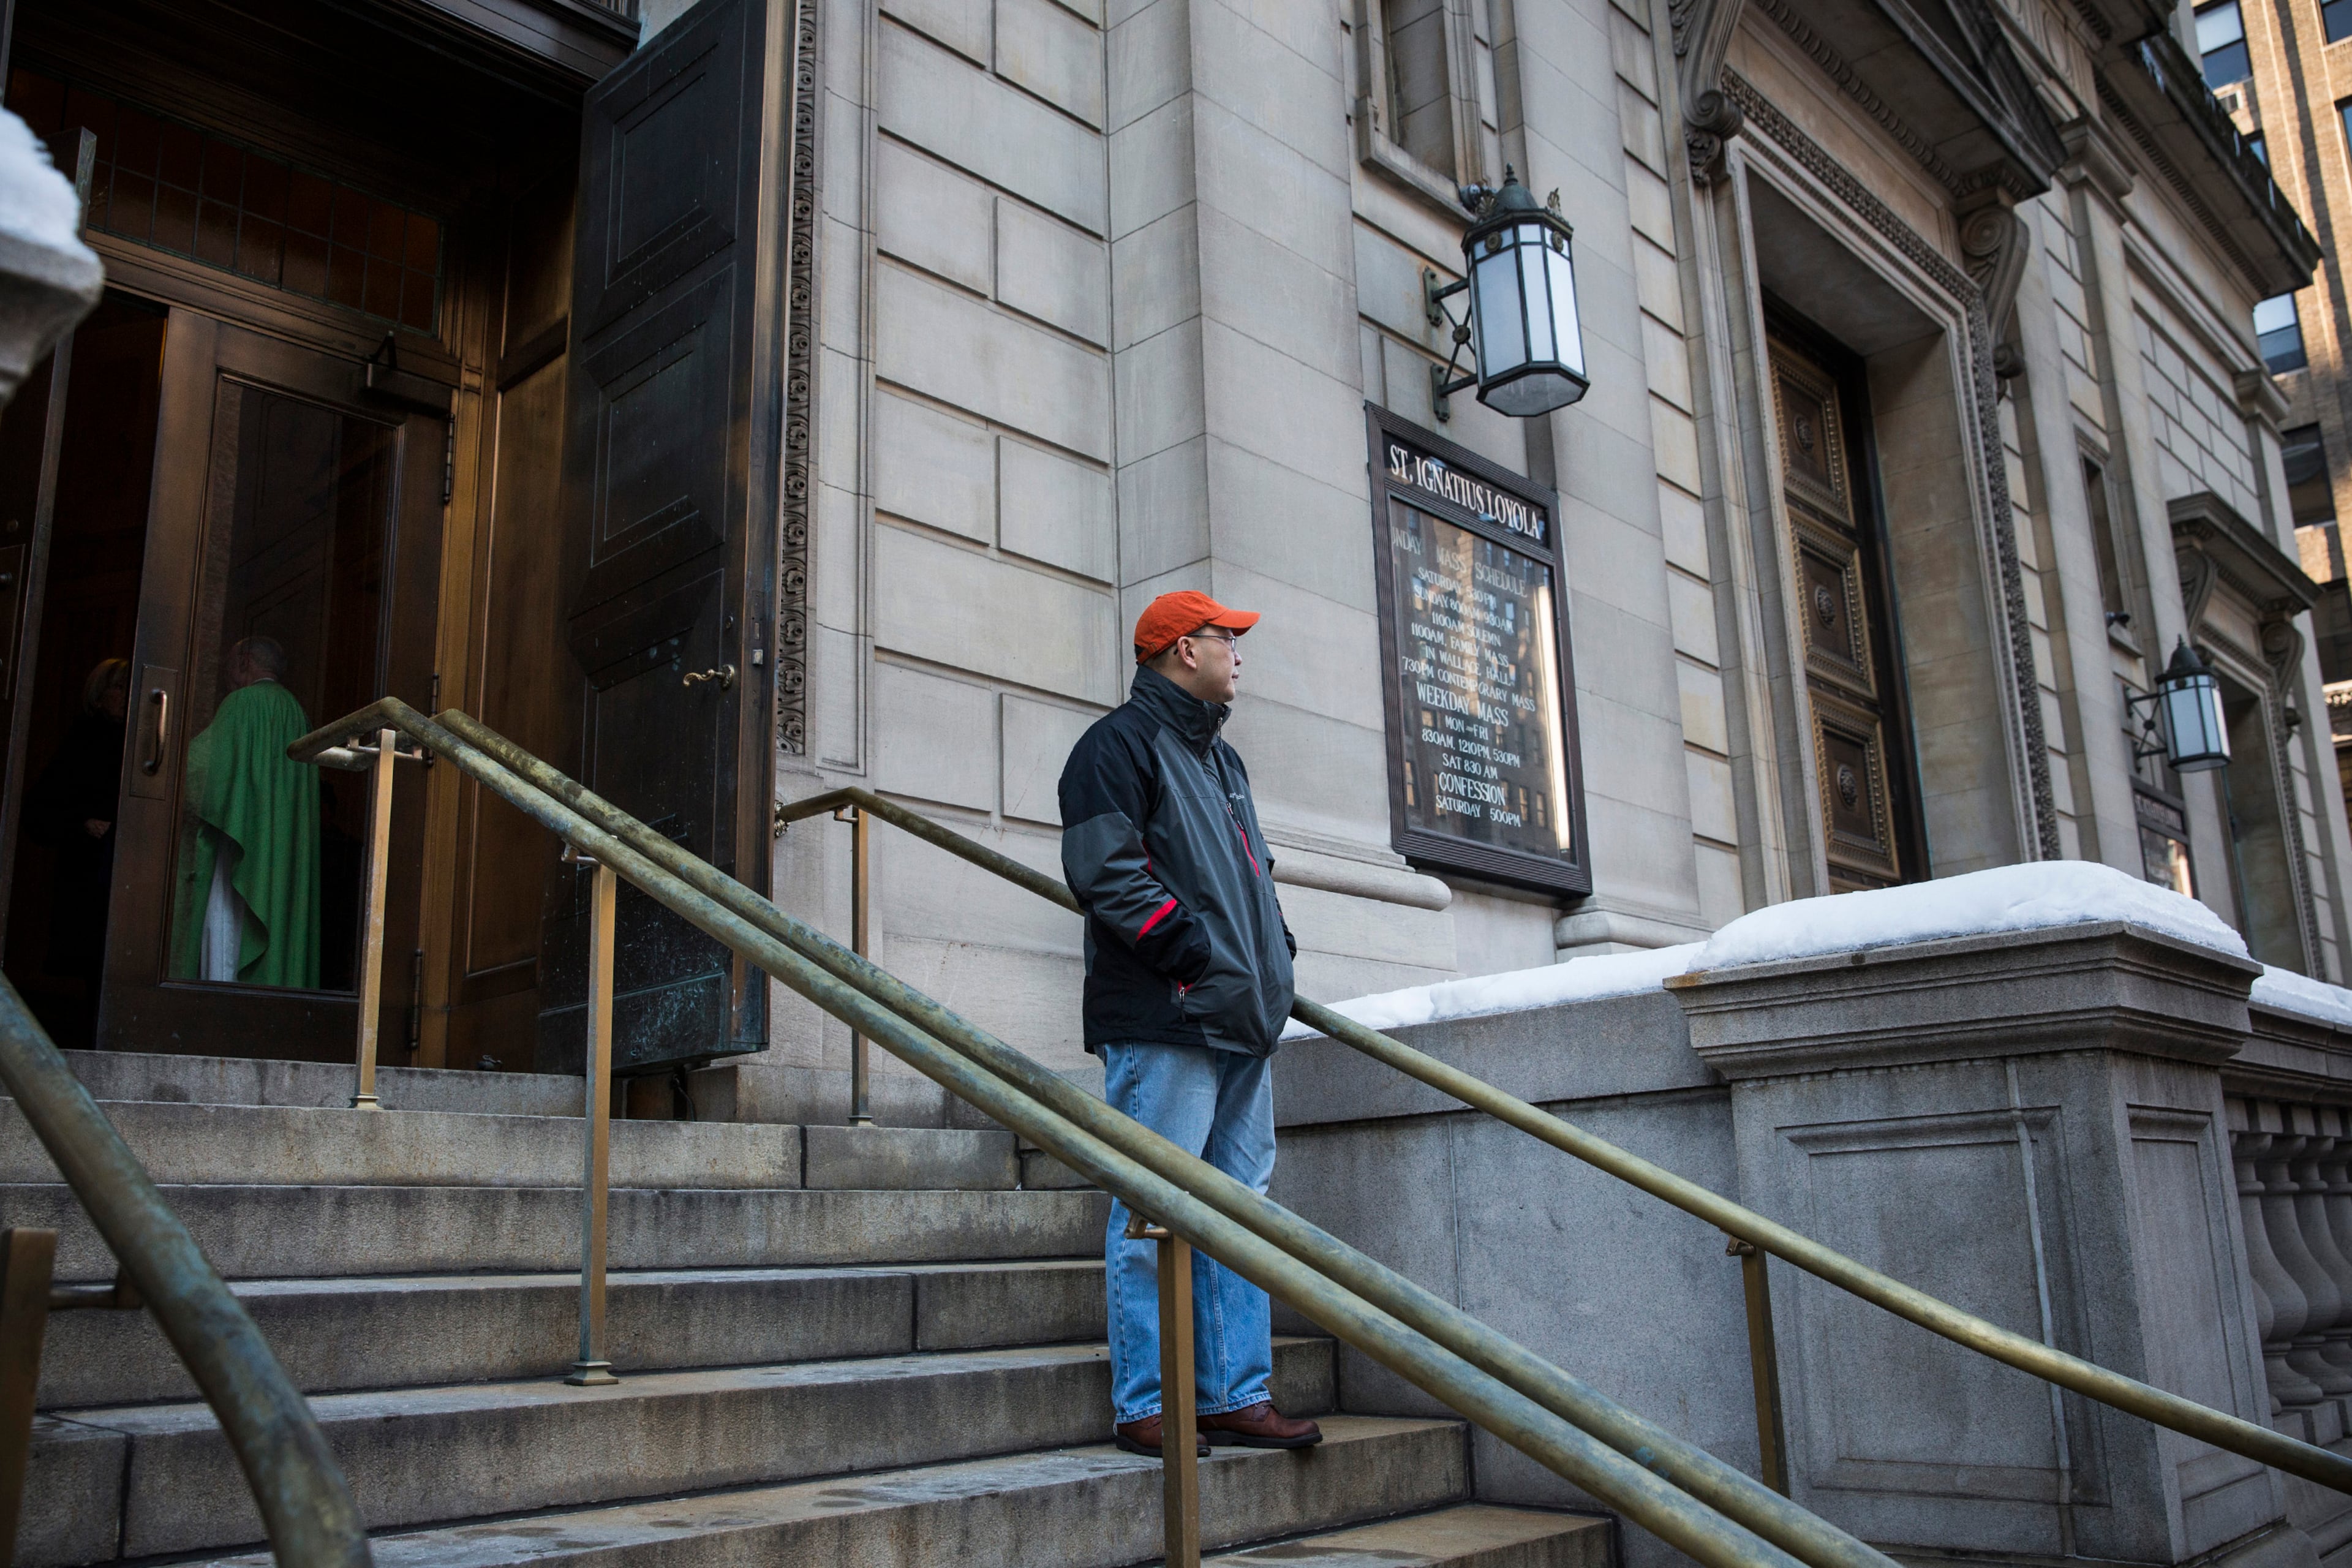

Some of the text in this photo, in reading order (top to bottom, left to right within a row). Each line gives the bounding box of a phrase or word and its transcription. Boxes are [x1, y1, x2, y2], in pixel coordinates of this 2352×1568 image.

[1390, 444, 1540, 540] ST. IGNATIUS LOYOLA
[1391, 526, 1528, 598] UNDAY MASS SCHEDULE
[1418, 567, 1462, 595] SATURDAY
[1414, 584, 1448, 608] SUNDAY
[1483, 611, 1514, 633] 930AM
[1432, 611, 1501, 647] 1100AM SOLEMN
[1425, 645, 1436, 660] IN
[1439, 650, 1481, 676] WALLACE
[1450, 636, 1480, 657] FAMILY
[1485, 648, 1509, 668] MASS
[1402, 656, 1434, 678] 730PM
[1512, 693, 1536, 712] MASS
[1416, 680, 1509, 727] WEEKDAY MASS
[1442, 753, 1498, 779] SAT 830 AM
[1493, 748, 1520, 768] 530PM
[1439, 772, 1506, 806] CONFESSION
[1436, 794, 1521, 827] SATURDAY 500PM
